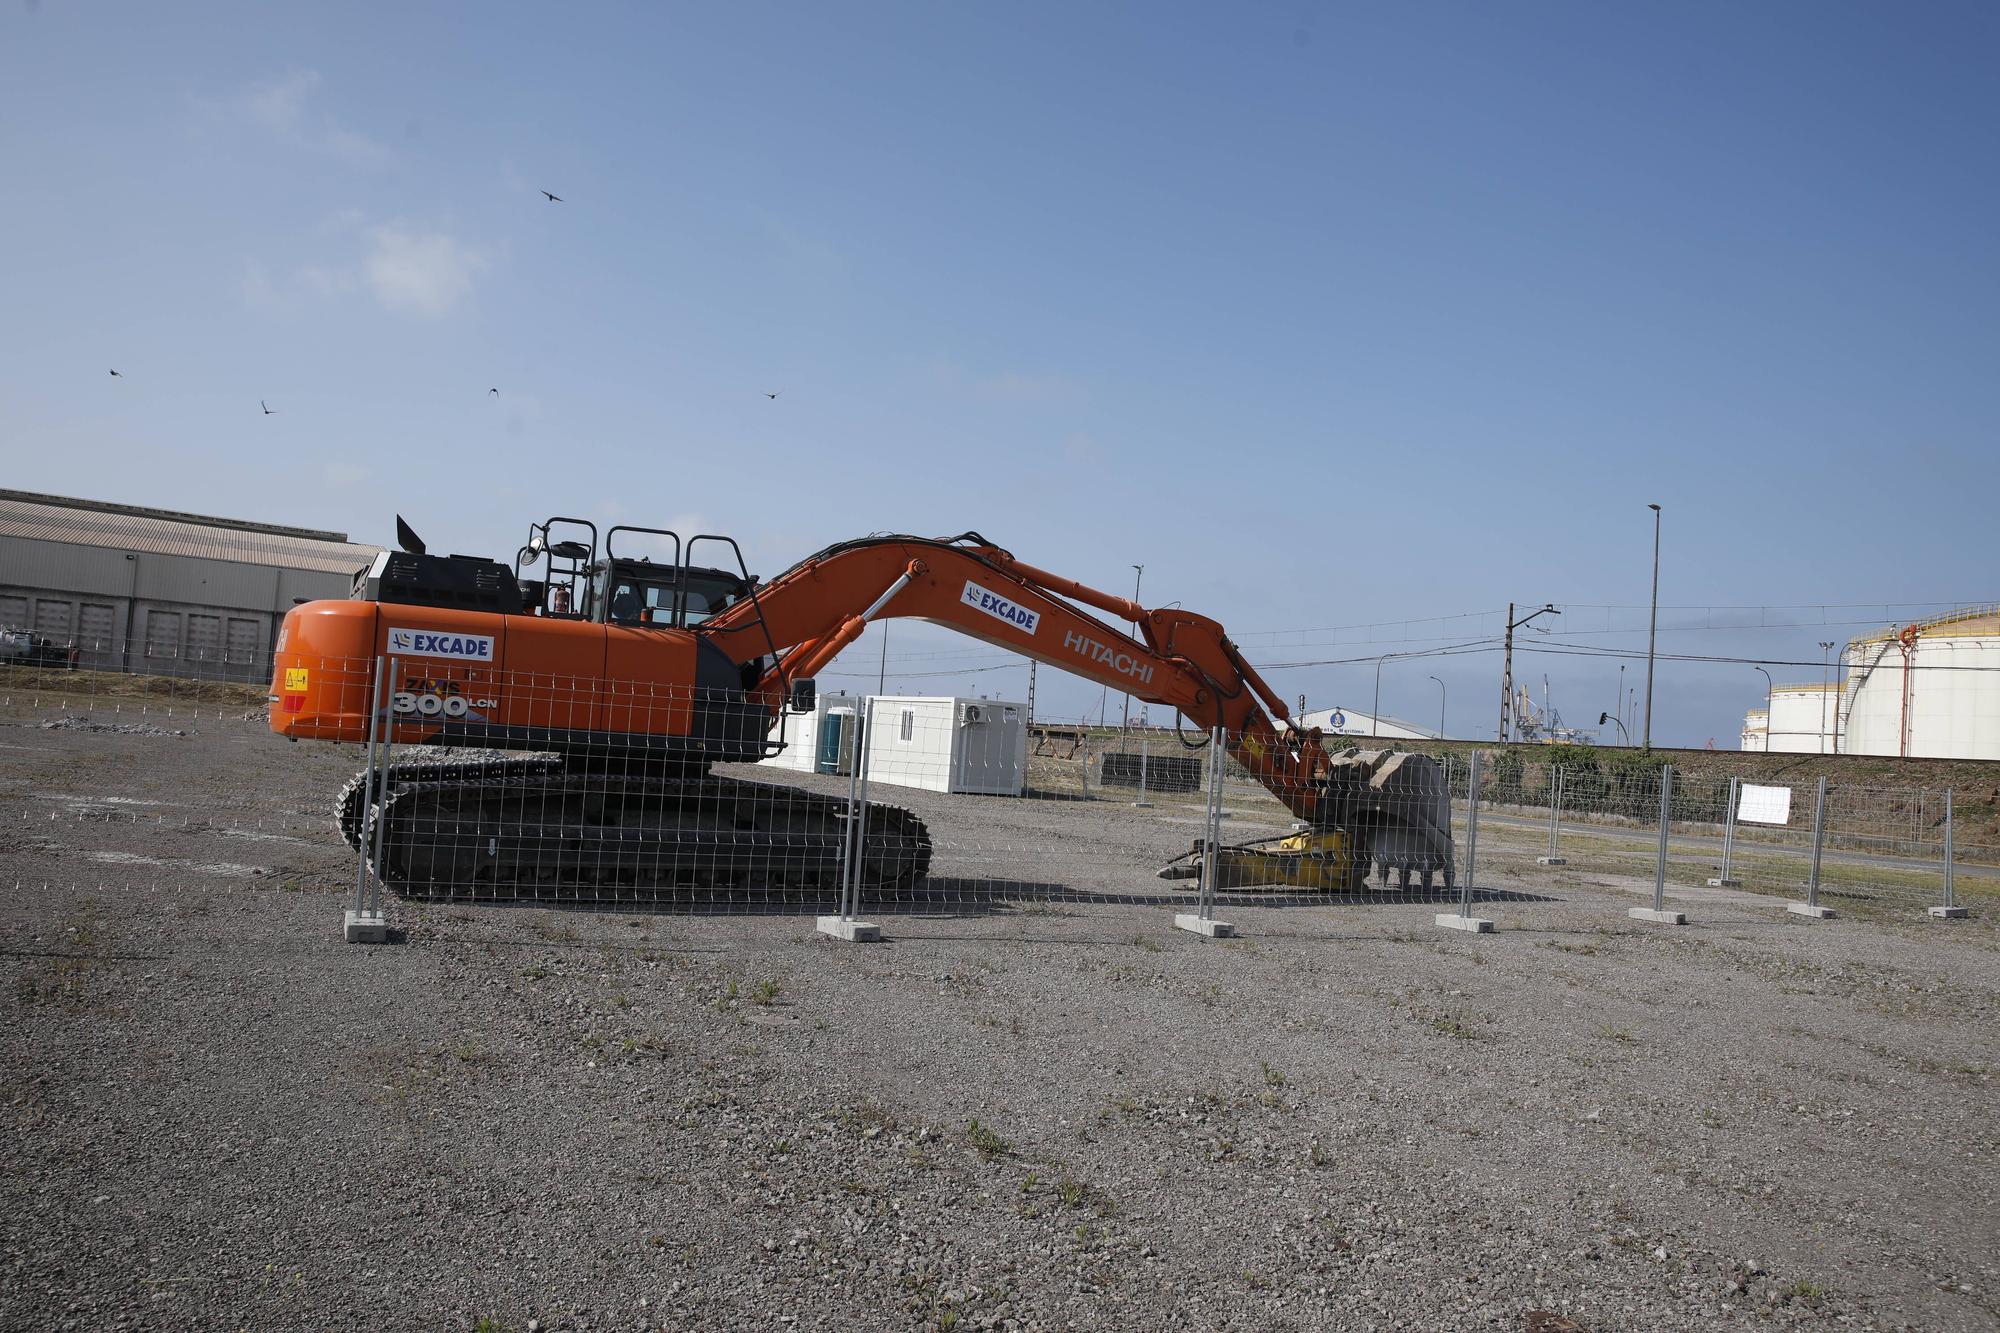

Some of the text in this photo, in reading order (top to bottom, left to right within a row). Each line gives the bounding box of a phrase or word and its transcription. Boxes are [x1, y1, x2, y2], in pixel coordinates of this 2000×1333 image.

[980, 593, 1035, 630] EXCADE
[414, 634, 488, 657] EXCADE
[1064, 630, 1154, 684] HITACHI
[393, 692, 498, 717] 300 LCN
